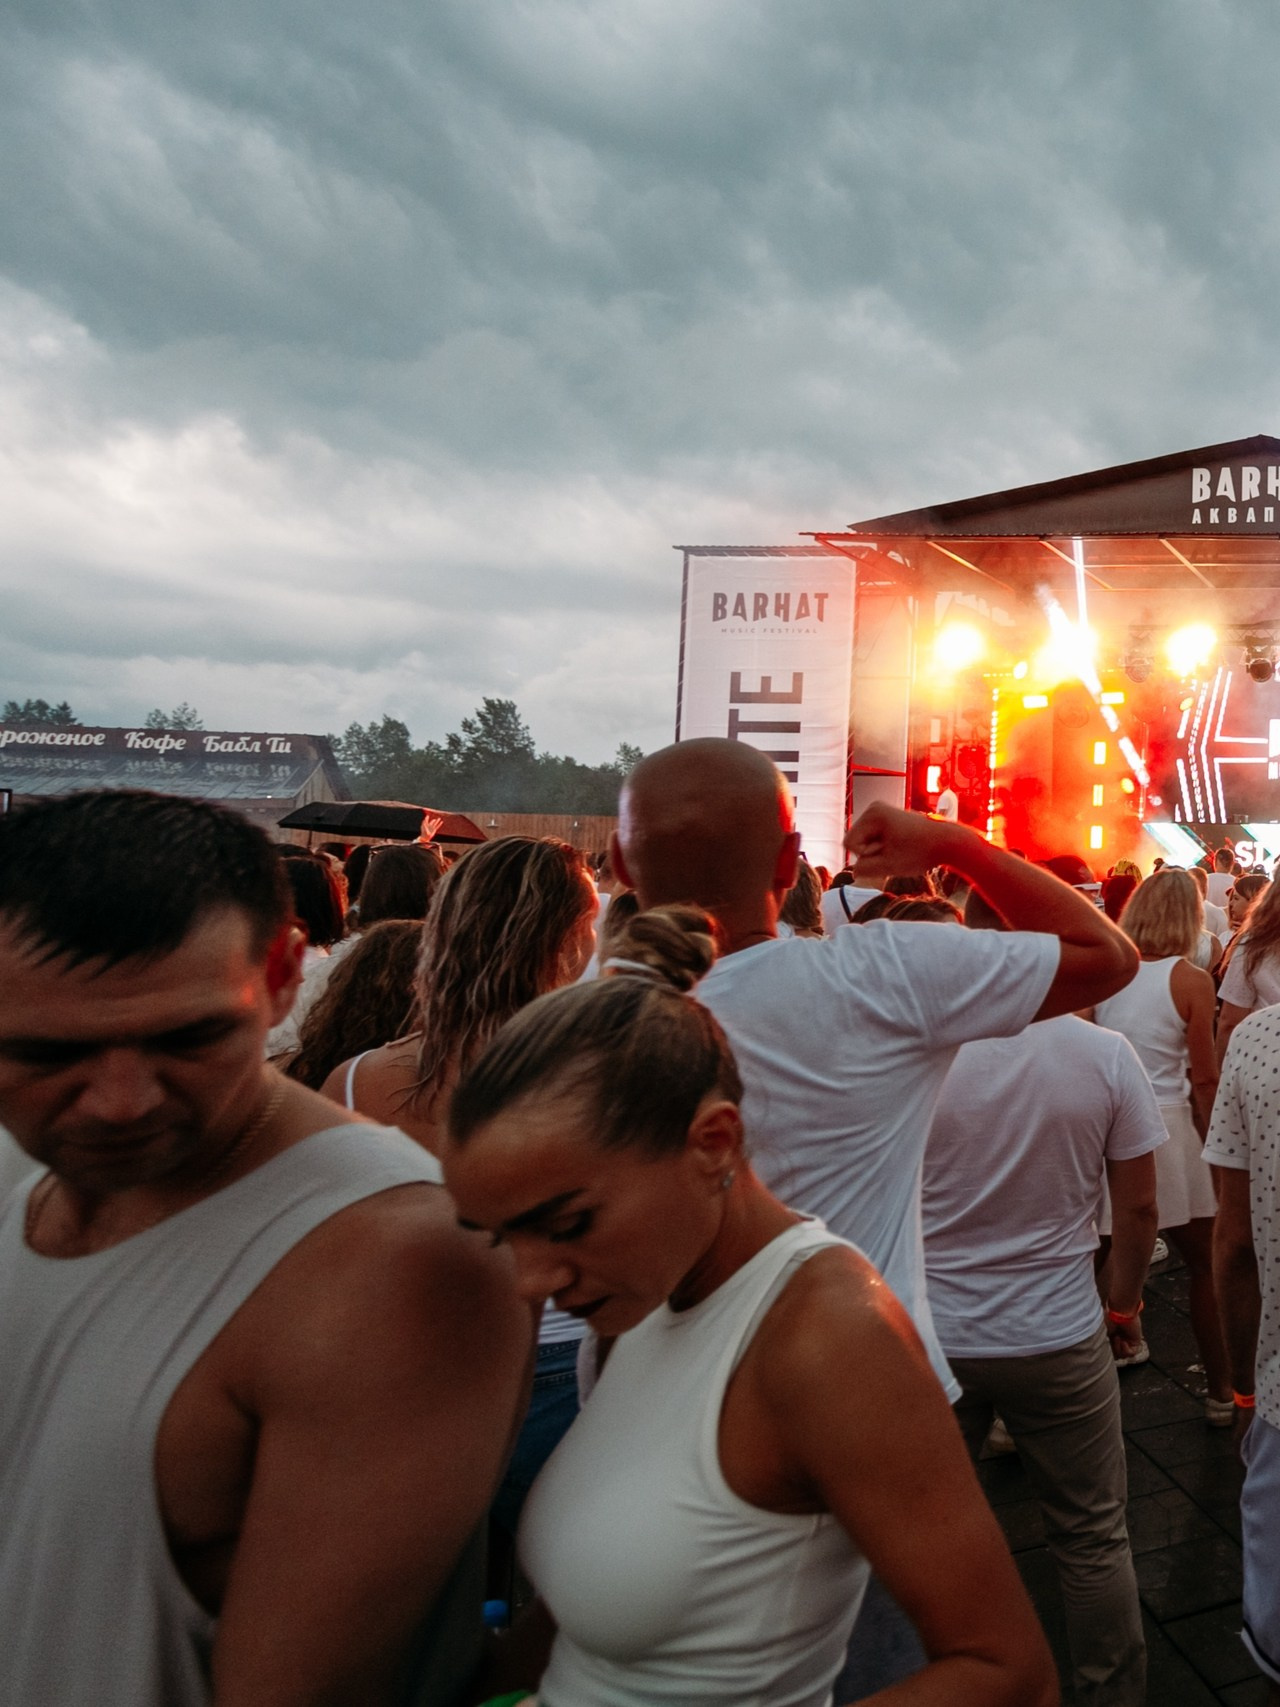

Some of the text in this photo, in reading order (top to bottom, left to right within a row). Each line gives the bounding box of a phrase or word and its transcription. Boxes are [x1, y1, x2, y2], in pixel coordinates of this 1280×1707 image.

[712, 592, 829, 623] BARHAT
[0, 730, 292, 754] роженое Кофе Бабл Ти
